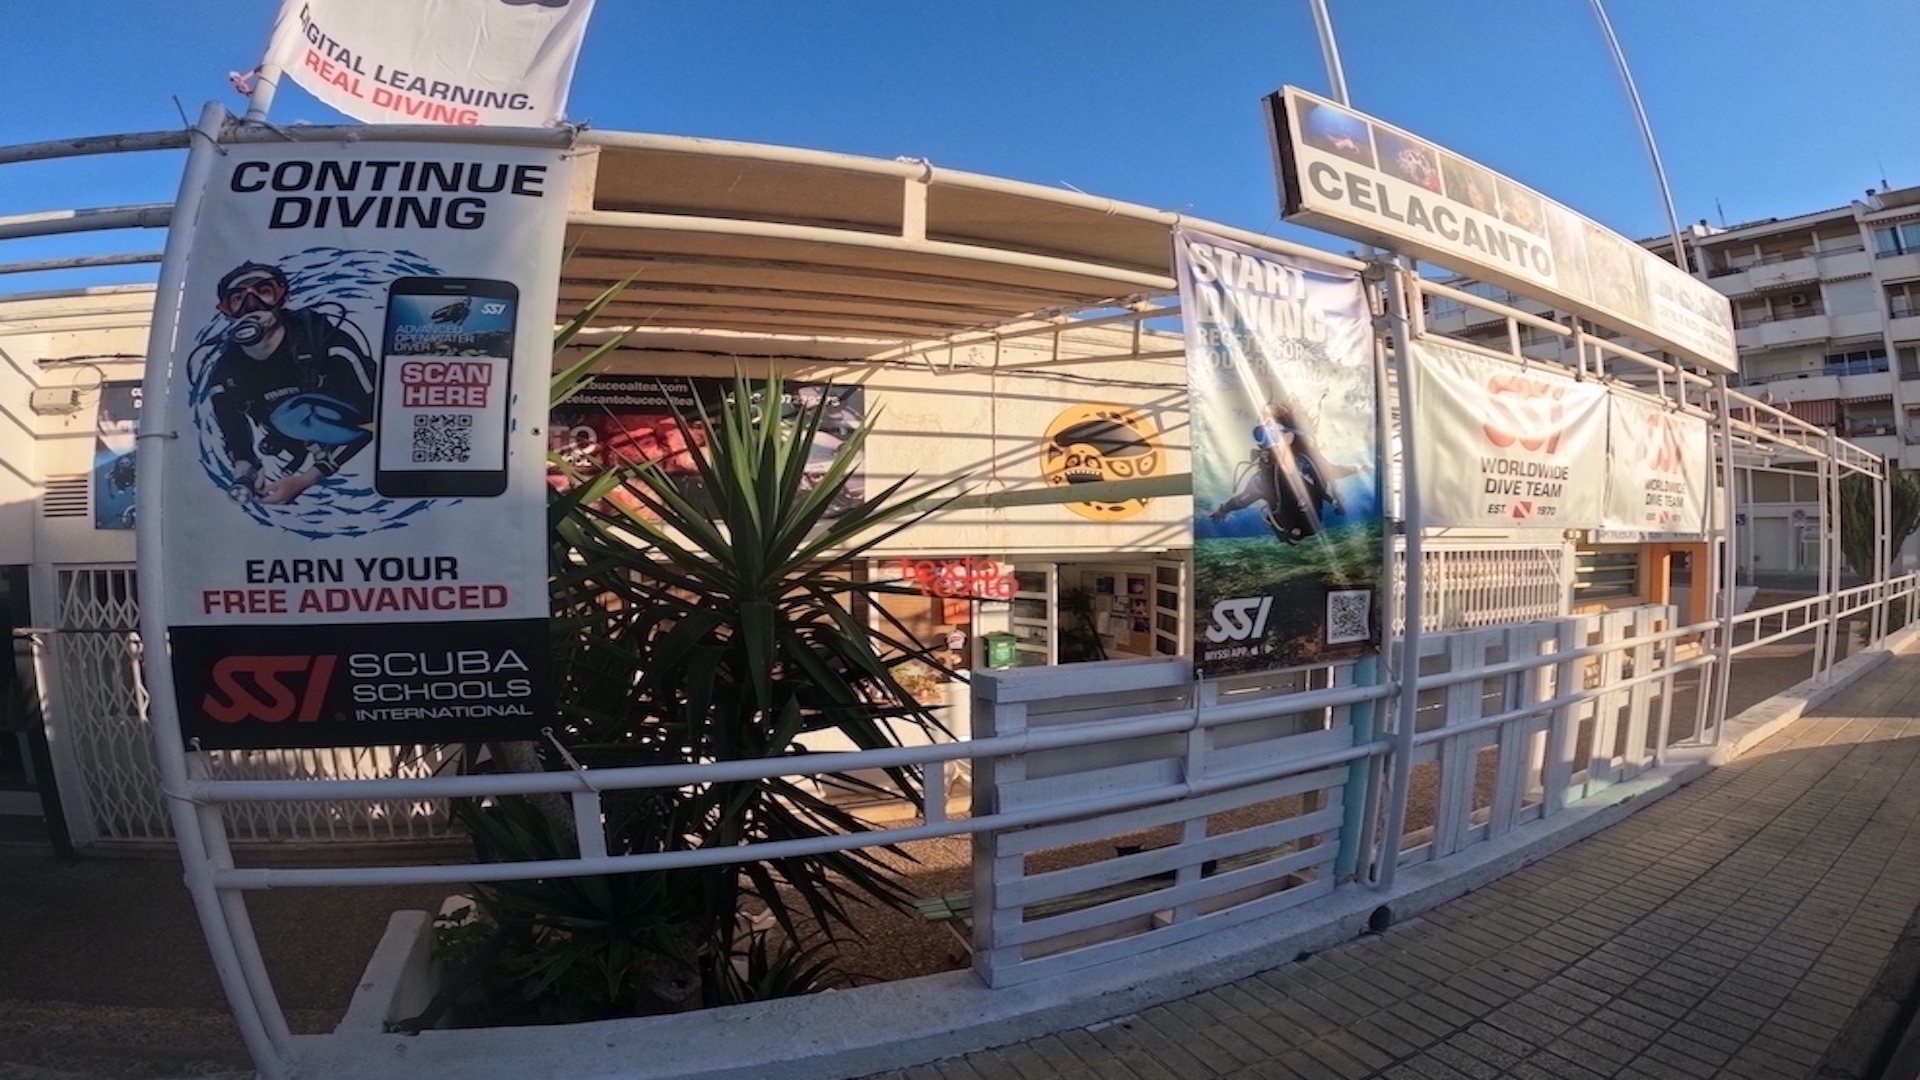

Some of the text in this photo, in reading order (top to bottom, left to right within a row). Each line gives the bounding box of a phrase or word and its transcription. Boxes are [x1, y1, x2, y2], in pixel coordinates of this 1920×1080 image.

[299, 2, 535, 111] DIGITAL LEARNING.
[304, 49, 364, 98] REAL
[231, 160, 547, 197] CONTINUE
[268, 197, 488, 229] DIVING
[1308, 160, 1553, 277] CELACANTO
[1188, 242, 1307, 300] START
[402, 362, 492, 385] SCAN
[404, 385, 487, 408] HERE
[1481, 456, 1569, 480] WORLDWIDE
[1485, 478, 1562, 498] DIVE TEAM
[246, 556, 459, 584] EARN YOUR
[203, 585, 509, 615] FREE ADVANCED
[1206, 596, 1275, 643] SSI
[349, 649, 530, 678] SCUBA
[202, 654, 338, 723] SSI
[353, 678, 532, 703] SCHOOLS
[355, 703, 534, 722] INTERNATIONAL
